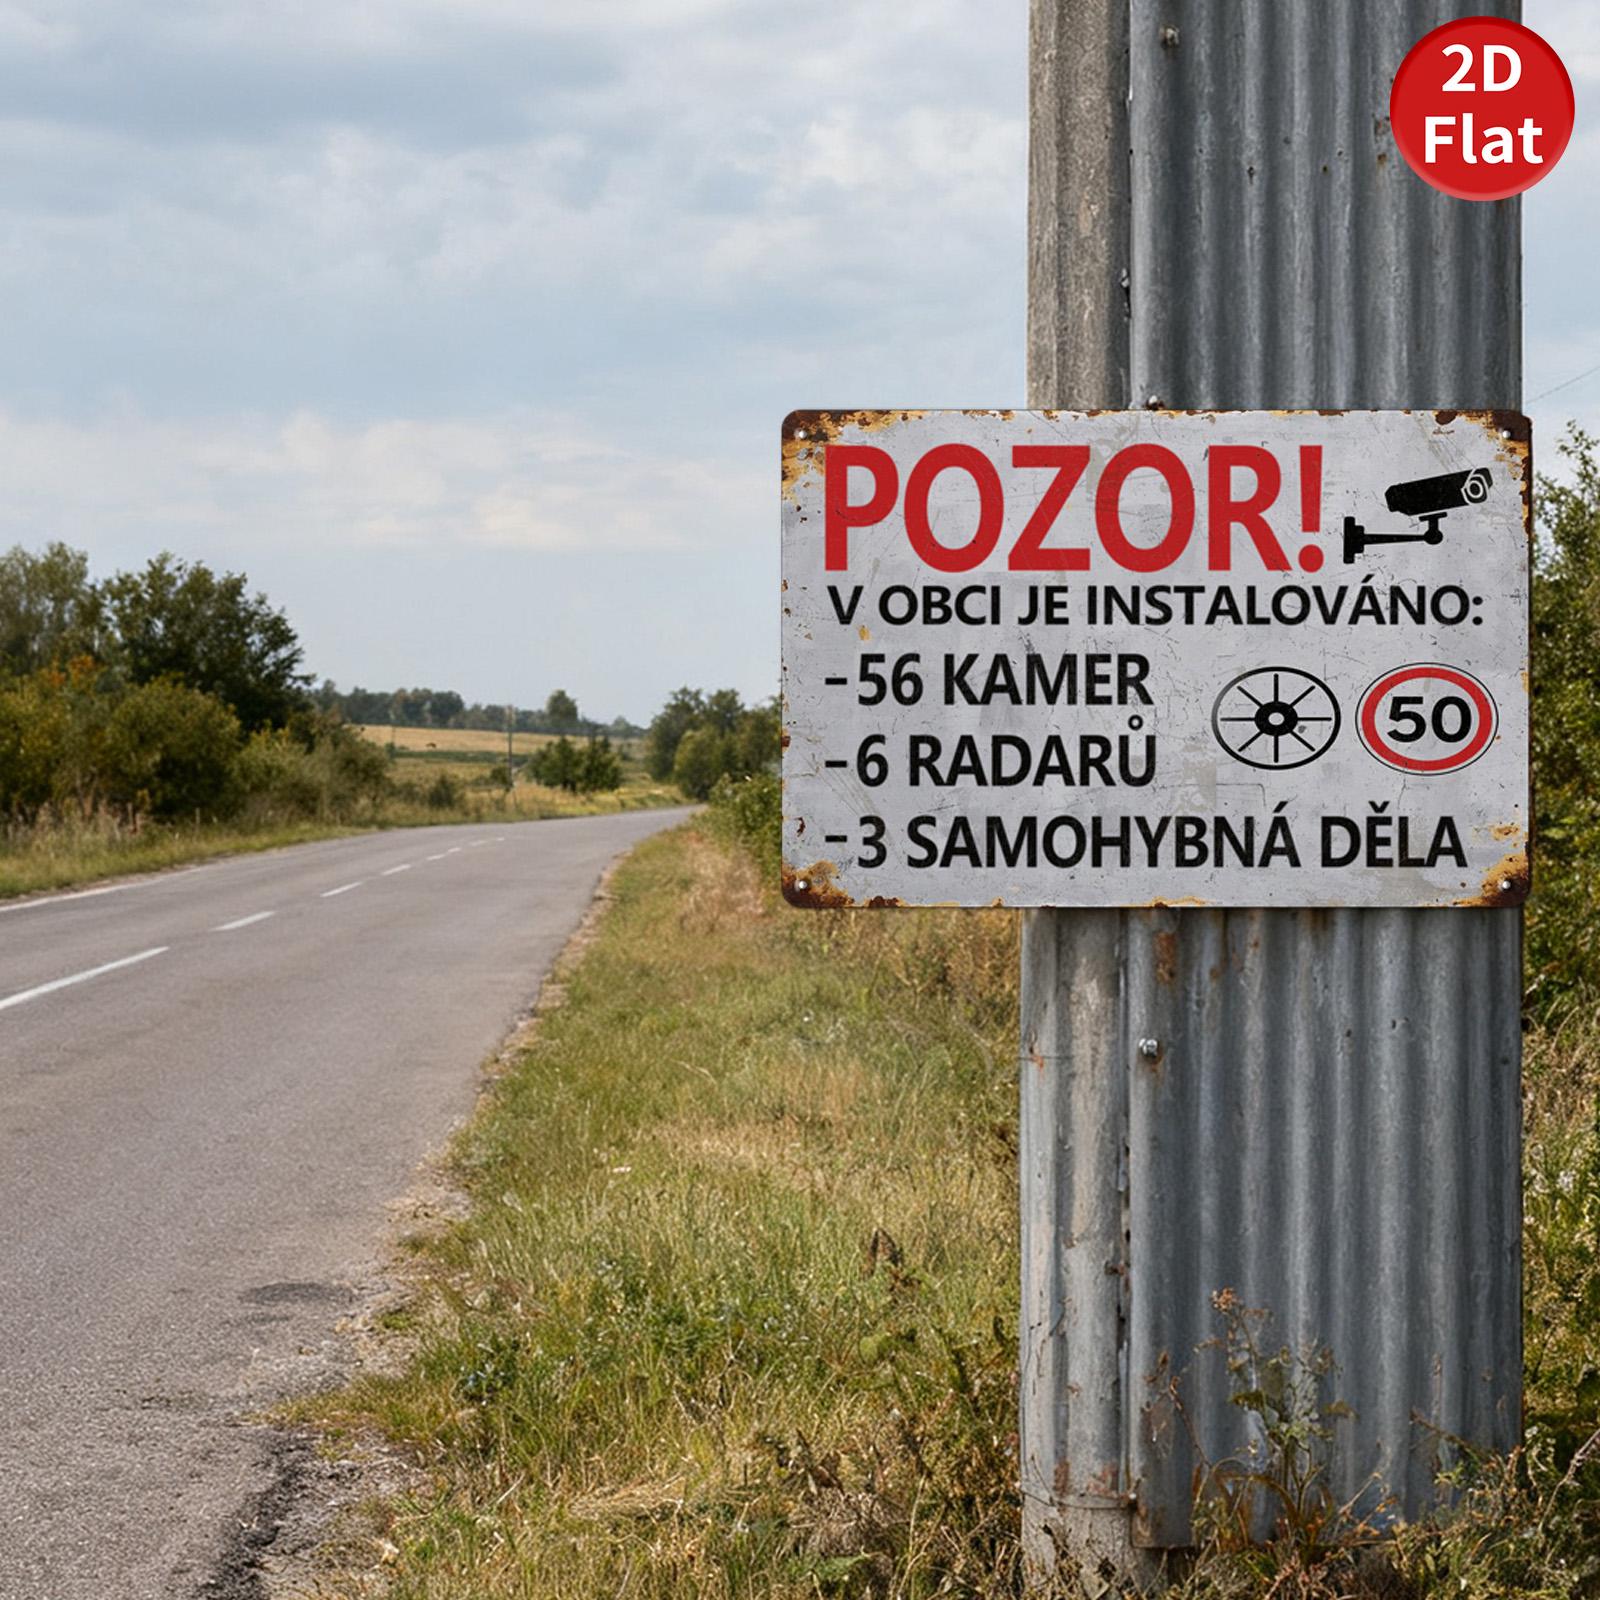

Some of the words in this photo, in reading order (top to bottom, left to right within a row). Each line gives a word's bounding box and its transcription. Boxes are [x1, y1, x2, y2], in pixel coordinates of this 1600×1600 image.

[825, 444, 1324, 572] POZOR!
[828, 585, 864, 625] V
[879, 585, 1001, 625] OBCI
[1018, 585, 1070, 625] JE
[1088, 575, 1483, 625] INSTALOVÁNO:
[944, 653, 1154, 706] KAMER
[1387, 695, 1474, 744] 50
[910, 715, 1157, 787] RADARŮ
[908, 801, 1302, 868] SAMOHYBNÁ
[1322, 801, 1468, 868] DĚLA
